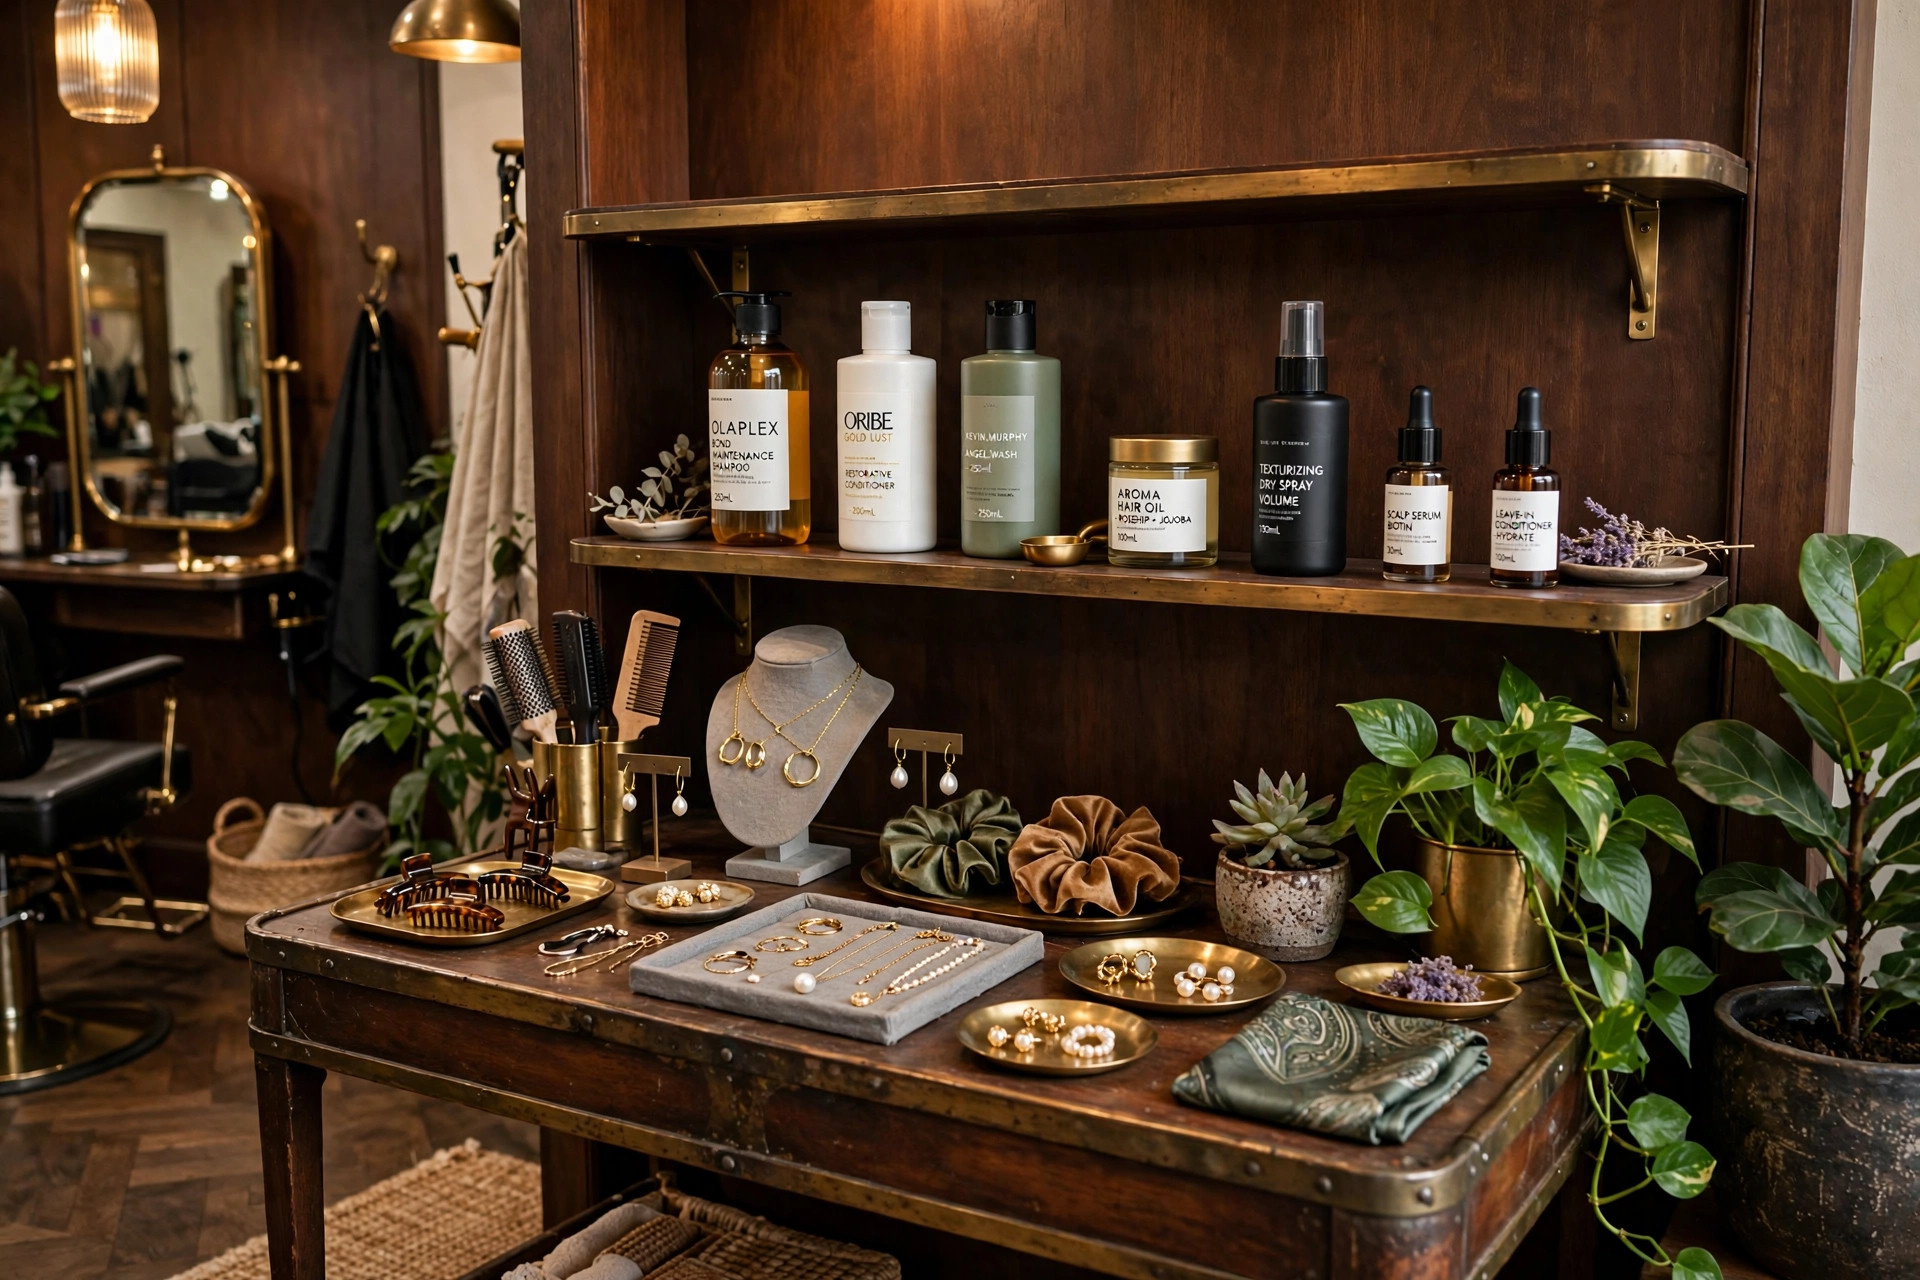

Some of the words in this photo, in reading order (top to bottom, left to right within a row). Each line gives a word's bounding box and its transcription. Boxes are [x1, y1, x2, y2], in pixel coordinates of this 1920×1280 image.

[844, 411, 894, 431] ORIBE
[712, 420, 779, 436] OLAPLEX
[844, 432, 867, 443] GOLD
[870, 433, 894, 443] LUST
[1260, 463, 1324, 476] TEXTURIZING
[1260, 478, 1277, 491] DRY
[1279, 479, 1314, 492] SPRAY
[1118, 488, 1161, 500] AROMA
[1260, 494, 1300, 507] VOLUME
[1118, 501, 1142, 513] HAIR
[1144, 502, 1165, 513] OIL
[1159, 516, 1192, 525] JOJOBA
[1387, 509, 1410, 520] SCALP
[1411, 511, 1442, 521] SERUM
